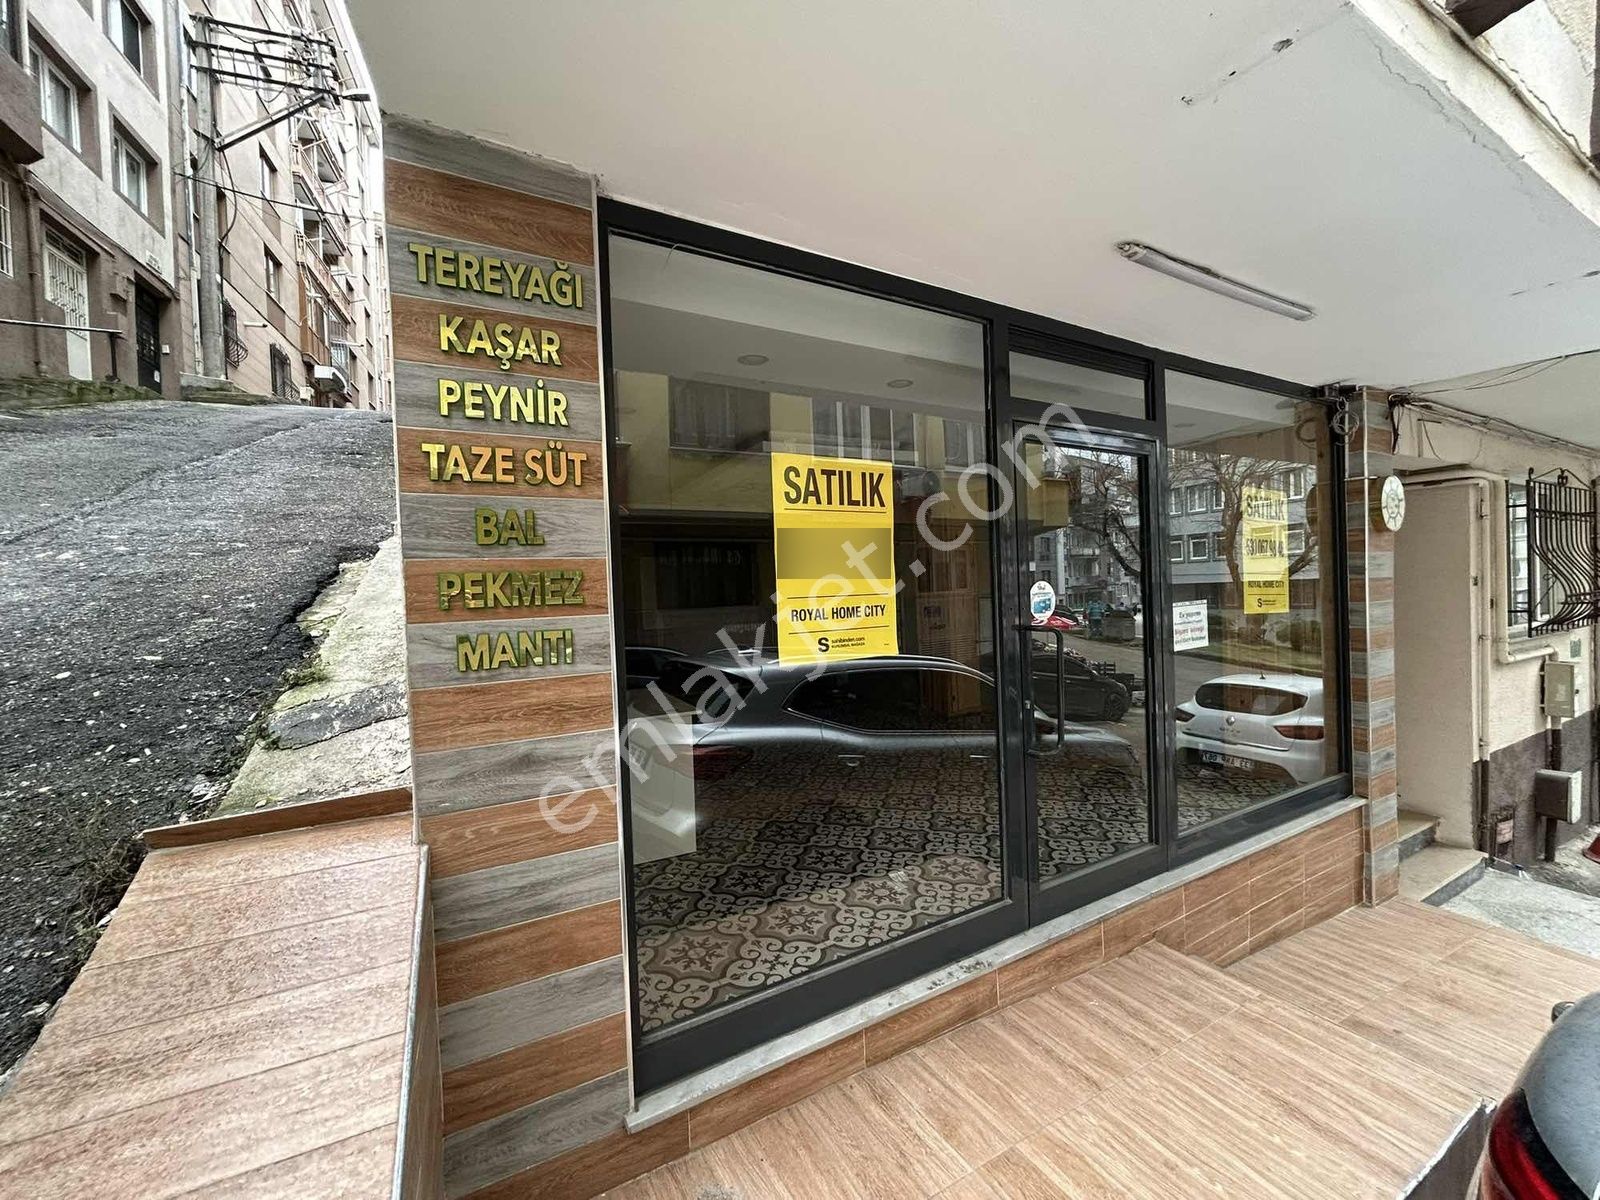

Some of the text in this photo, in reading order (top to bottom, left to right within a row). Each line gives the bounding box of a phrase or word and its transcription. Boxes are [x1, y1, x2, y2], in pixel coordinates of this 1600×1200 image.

[408, 242, 583, 308] TEREYAĞI
[438, 314, 562, 370] KAŞAR
[438, 378, 569, 427] PEYNİR
[421, 440, 587, 487] TAZE SÜT
[783, 465, 886, 508] SATILIK
[474, 507, 545, 546] BAL
[437, 569, 584, 611] PEKMEZ
[791, 604, 886, 622] ROYAL HOME CITY
[456, 628, 573, 672] MANTI
